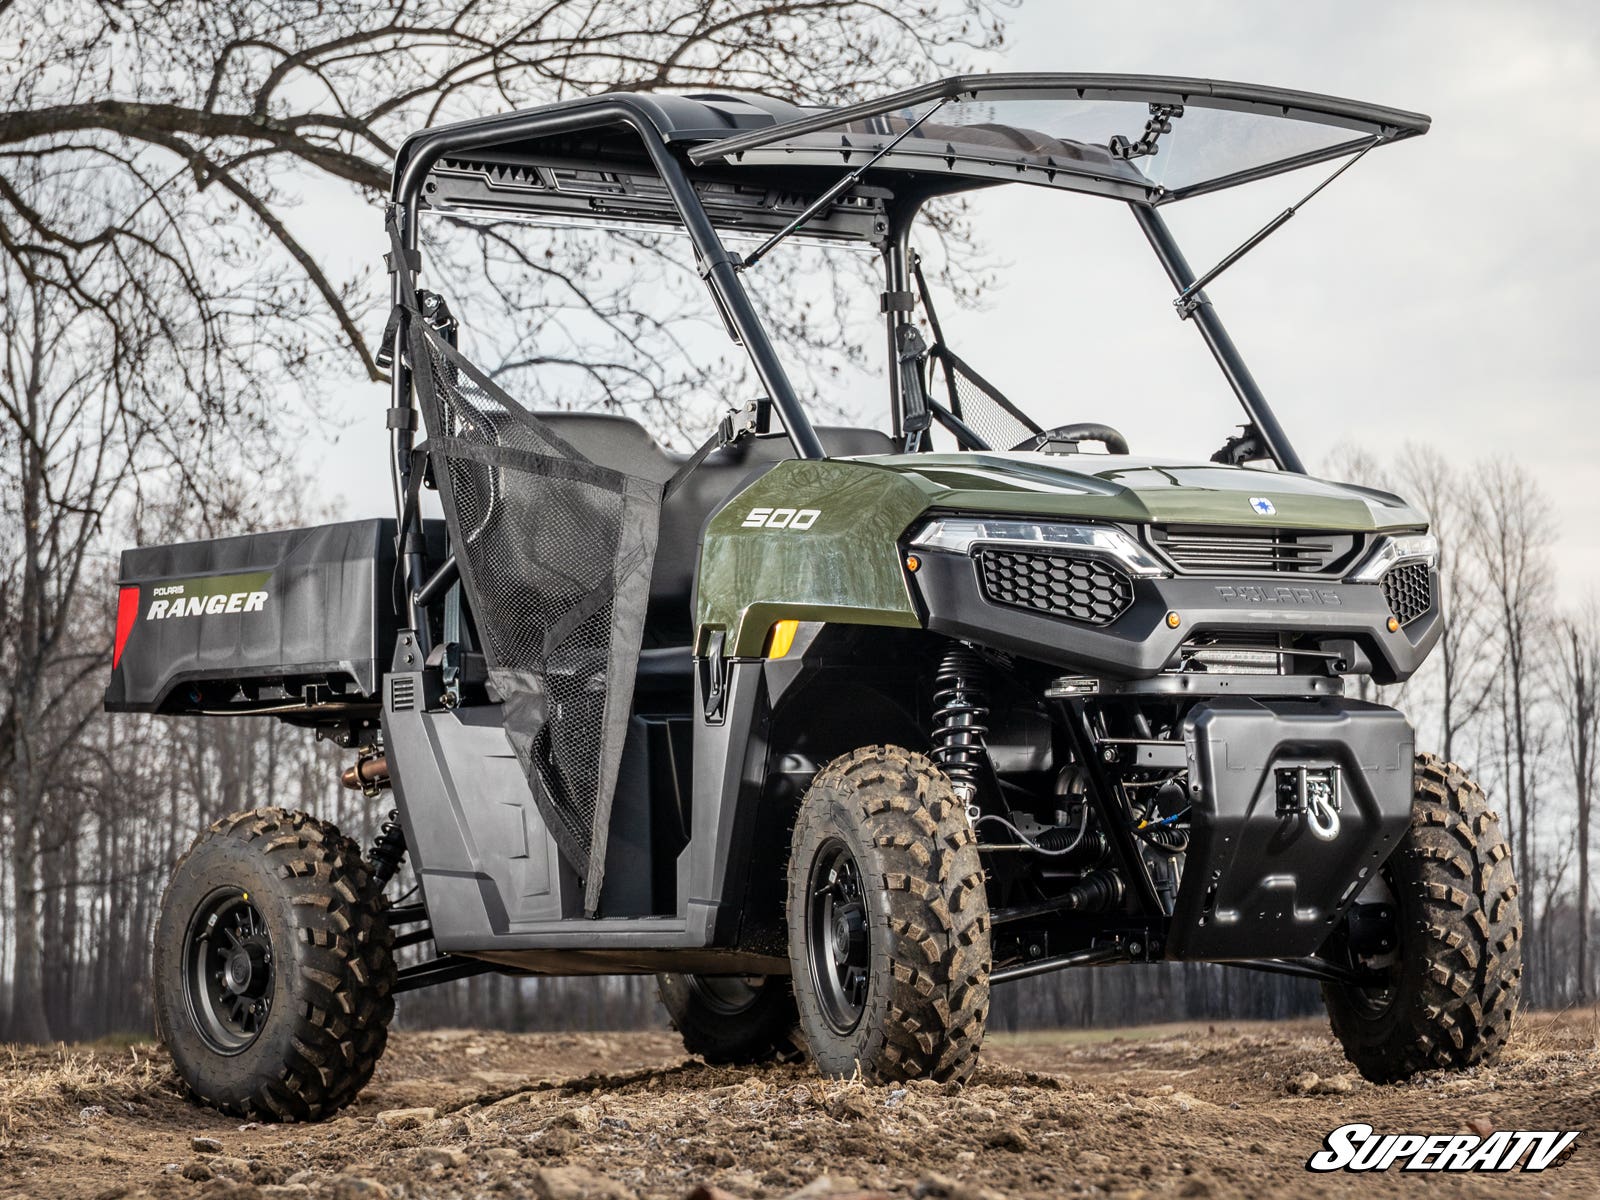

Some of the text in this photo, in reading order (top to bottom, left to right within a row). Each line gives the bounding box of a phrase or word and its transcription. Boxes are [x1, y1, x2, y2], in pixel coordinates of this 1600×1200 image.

[741, 508, 821, 530] 500
[153, 585, 184, 596] POLARIS
[1215, 586, 1343, 605] POLARIS
[146, 591, 269, 621] RANGER
